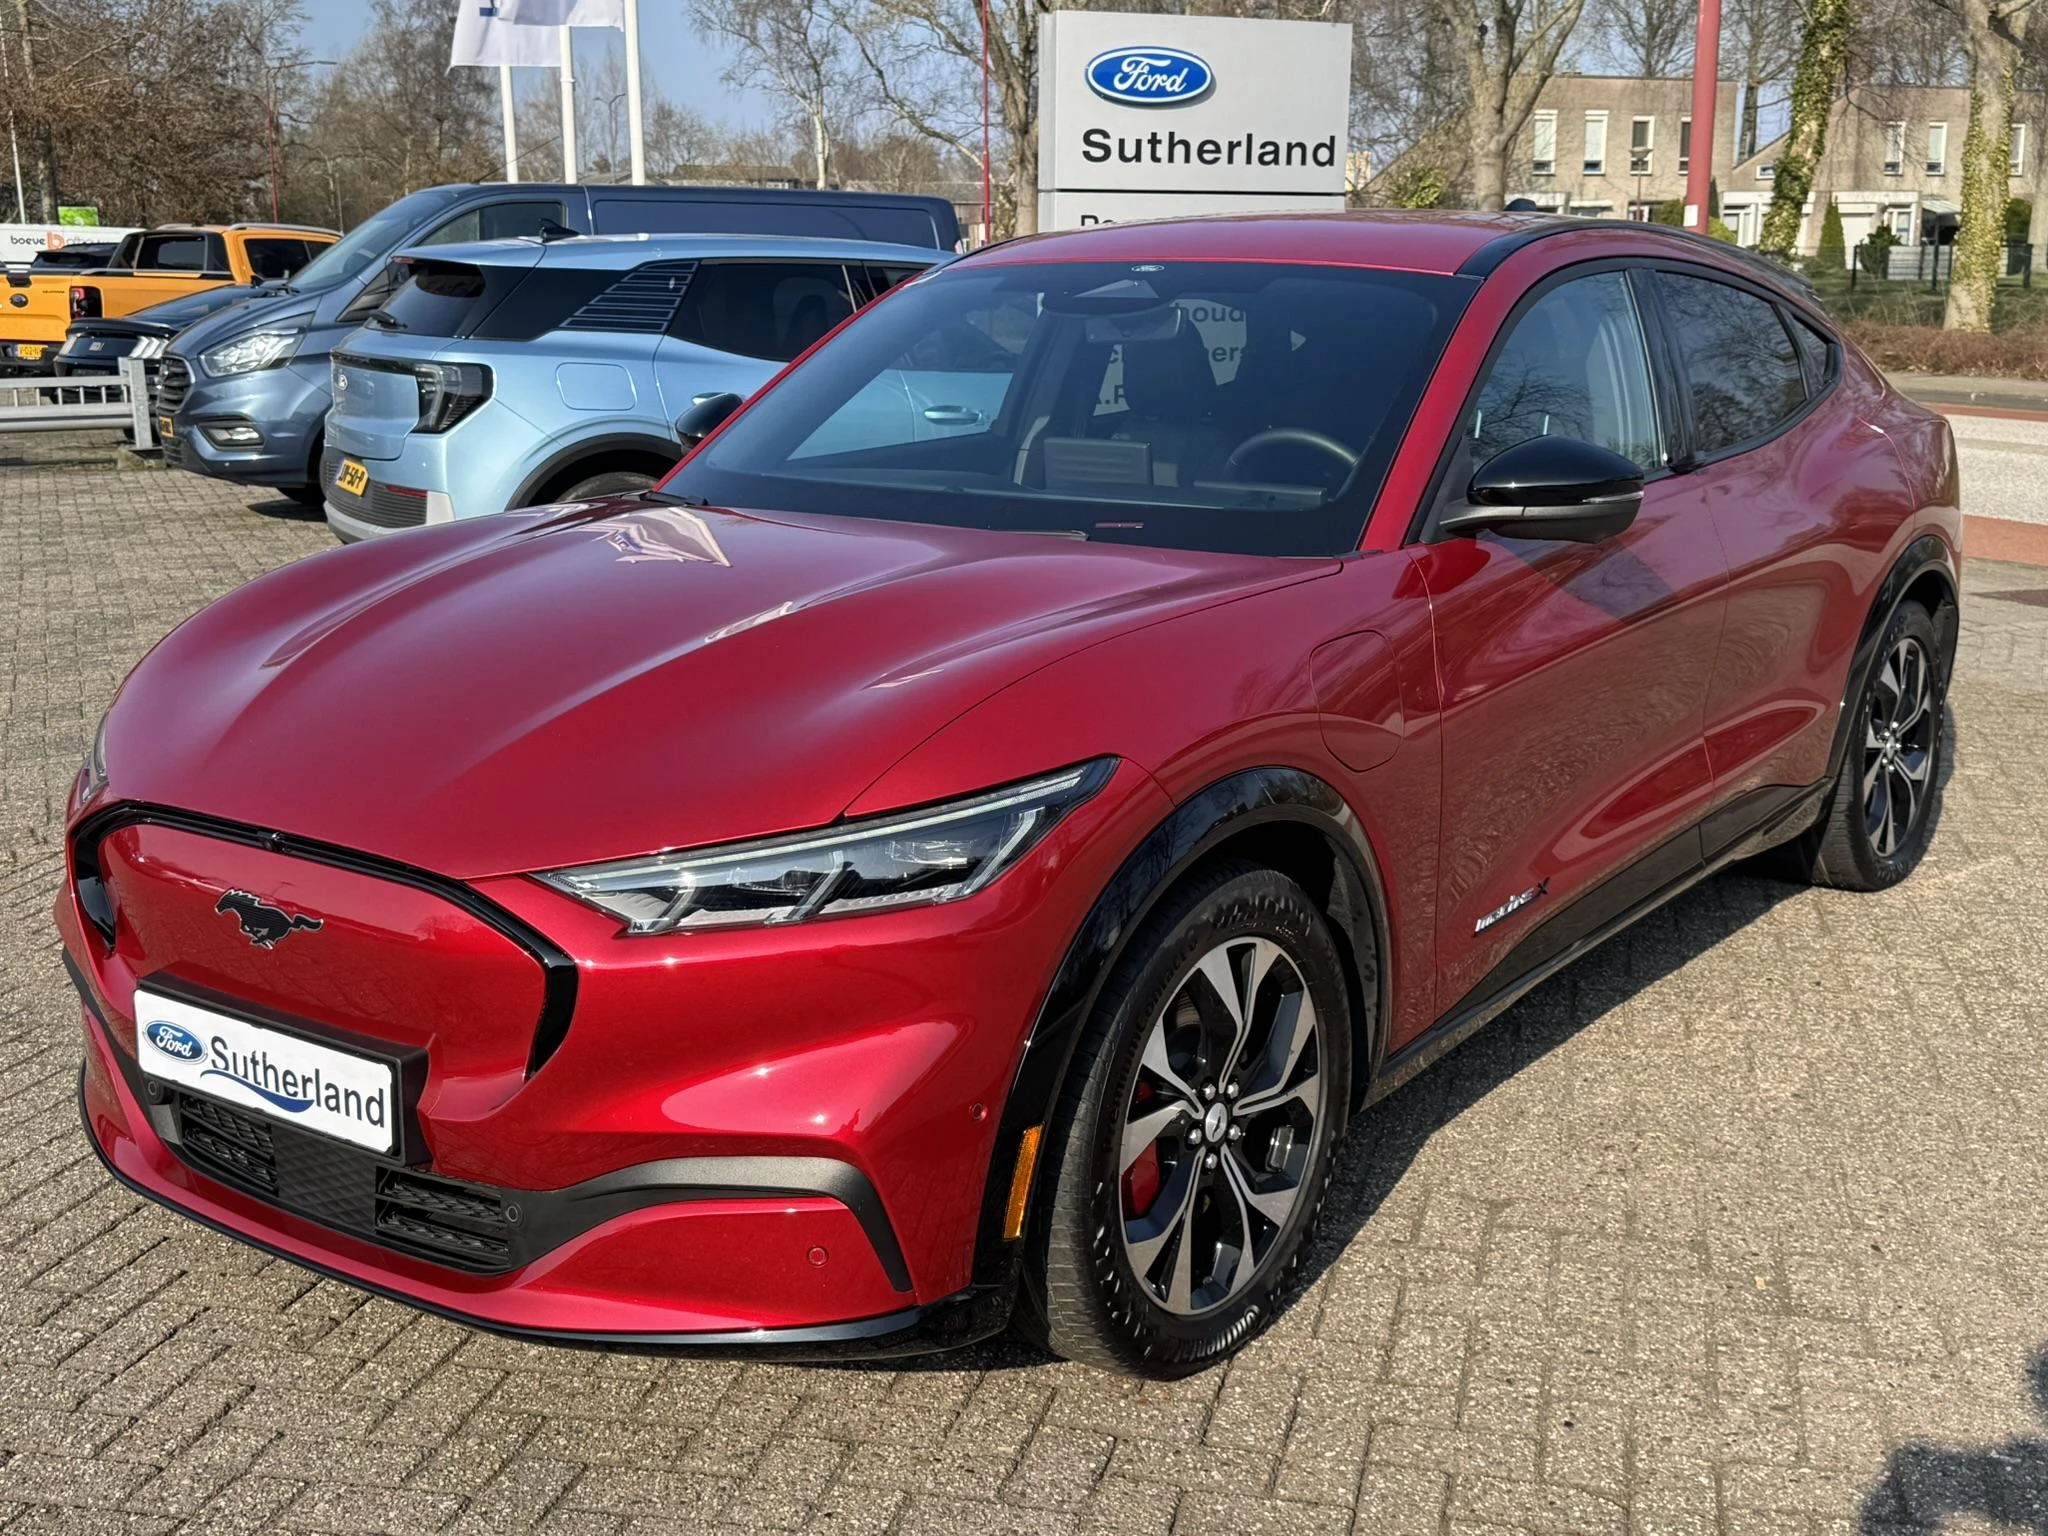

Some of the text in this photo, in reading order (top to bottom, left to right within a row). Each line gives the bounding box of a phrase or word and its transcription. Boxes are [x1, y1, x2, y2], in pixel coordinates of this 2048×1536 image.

[1113, 56, 1189, 92] Ford
[1082, 127, 1336, 167] Sutherland
[155, 1025, 193, 1057] Ford
[210, 1035, 384, 1128] Sutherland
